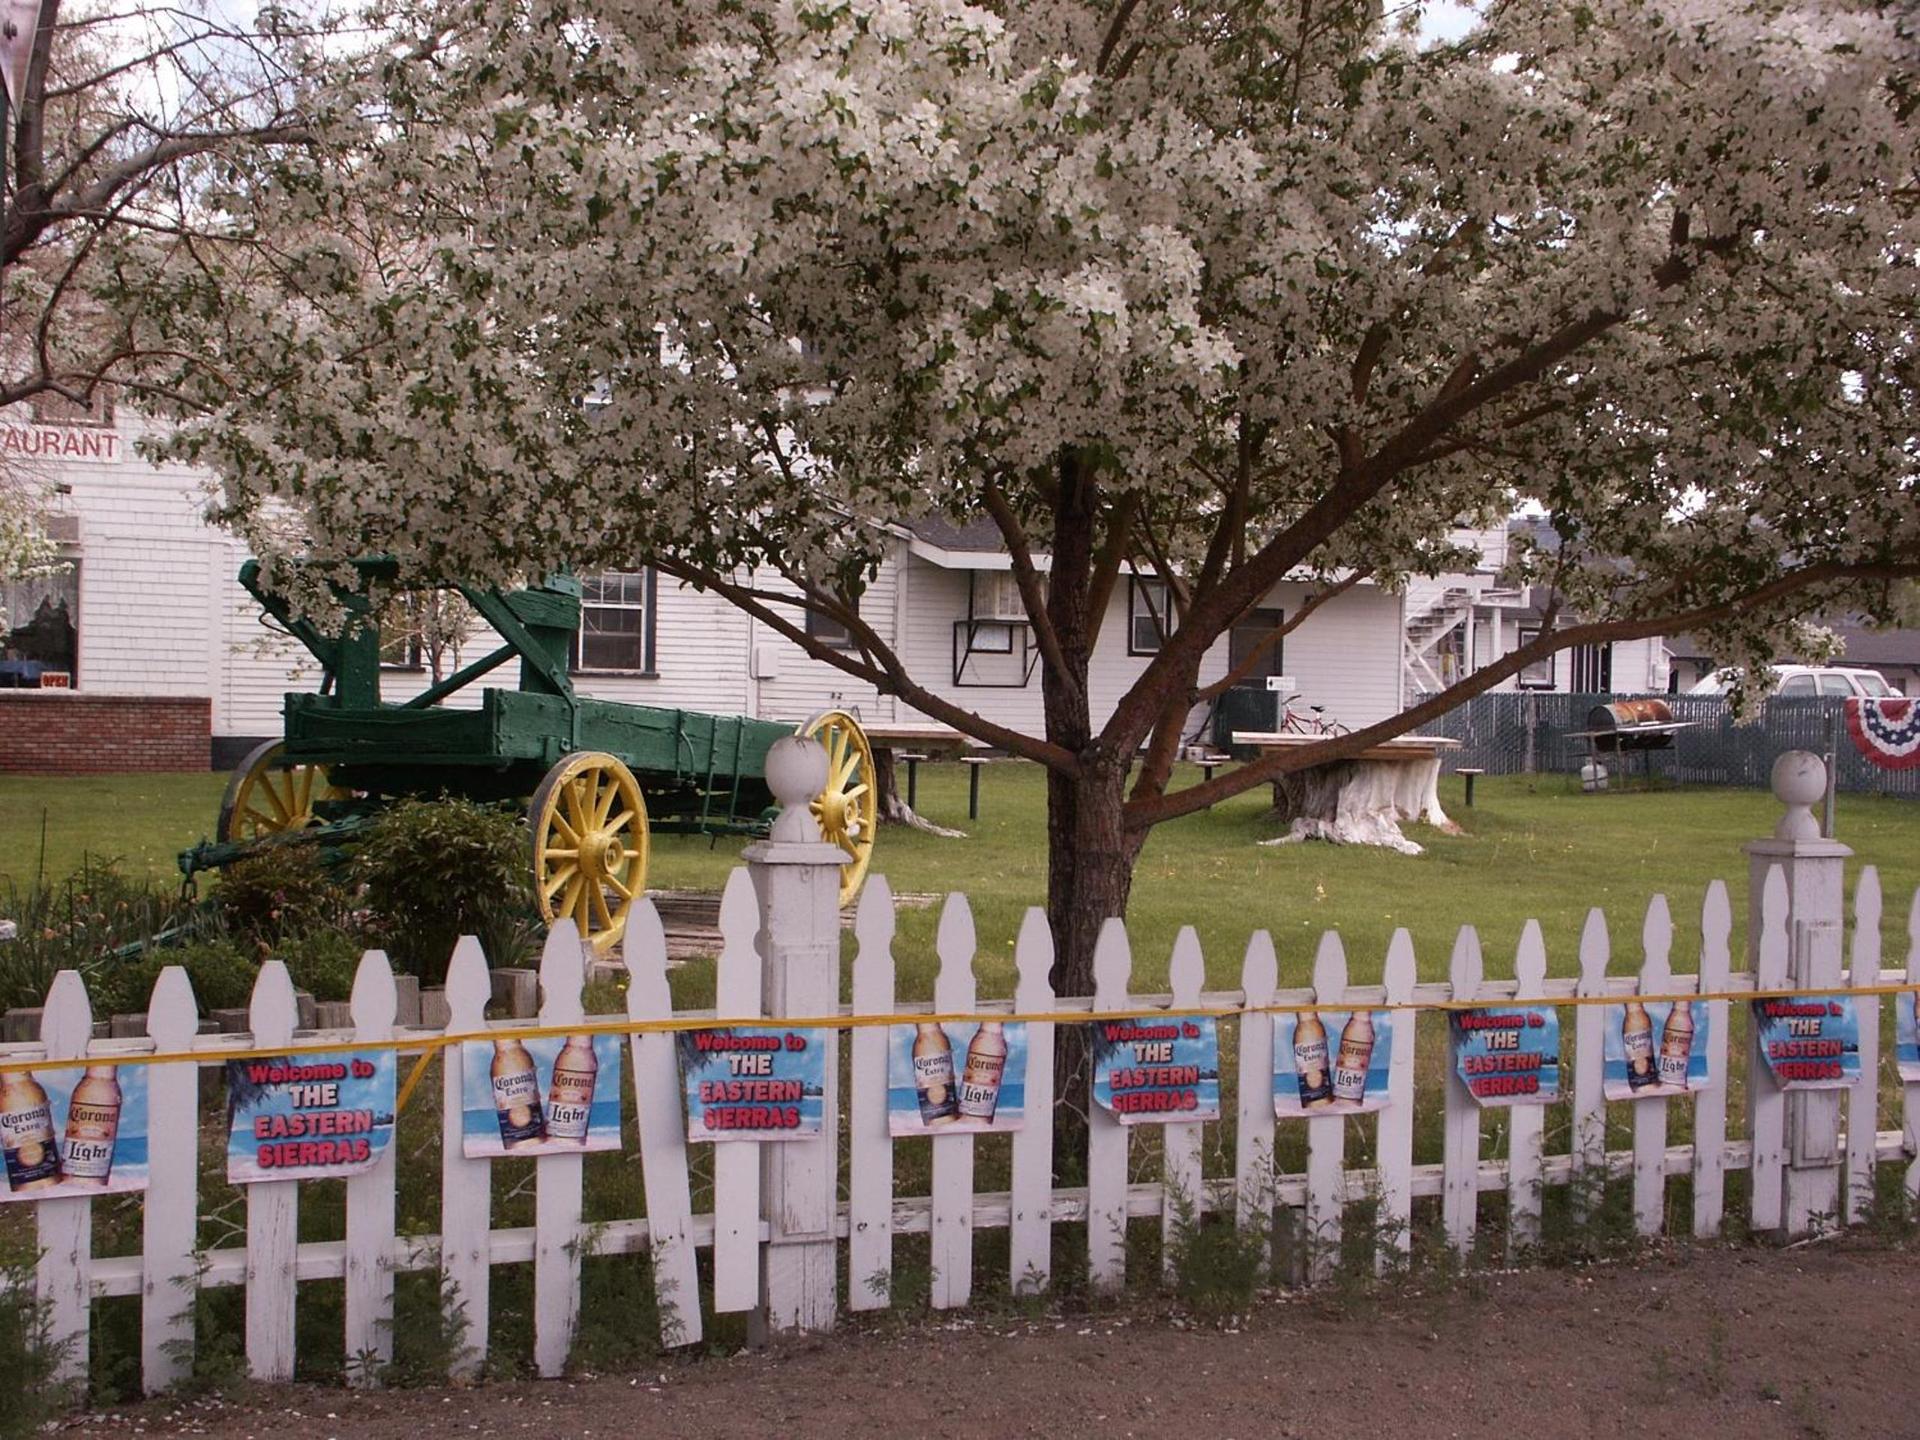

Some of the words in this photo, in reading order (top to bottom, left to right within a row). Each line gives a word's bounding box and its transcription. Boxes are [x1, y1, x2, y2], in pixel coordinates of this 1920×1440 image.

[0, 427, 119, 458] AURANT
[1461, 1014, 1525, 1030] Welcome
[1527, 1010, 1546, 1028] to
[1789, 1019, 1821, 1037] THE
[694, 1031, 781, 1052] Welcome
[784, 1032, 806, 1052] to
[1105, 1024, 1179, 1043] Welcome
[1182, 1021, 1201, 1039] to
[1484, 1031, 1519, 1051] THE
[1135, 1042, 1173, 1064] THE
[1767, 1040, 1844, 1059] EASTERN
[247, 1062, 348, 1084] Welcome
[351, 1058, 375, 1078] to
[729, 1054, 773, 1077] THE
[1464, 1053, 1542, 1076] EASTERN
[1772, 1062, 1844, 1081] IERRAS
[495, 1072, 534, 1091] Corona
[1109, 1066, 1199, 1089] EASTERN
[1469, 1074, 1540, 1097] IERRAS
[289, 1083, 339, 1108] THE
[505, 1086, 529, 1097] Extra
[699, 1080, 804, 1103] EASTERN
[964, 1085, 994, 1103] Light
[1111, 1088, 1198, 1113] SIERRAS
[1, 1107, 50, 1128] Corona
[254, 1109, 373, 1139] EASTERN
[551, 1104, 585, 1123] Light
[704, 1105, 801, 1130] SIERRAS
[14, 1122, 41, 1134] Extra
[68, 1141, 107, 1161] Light
[257, 1138, 371, 1168] SIERRAS
